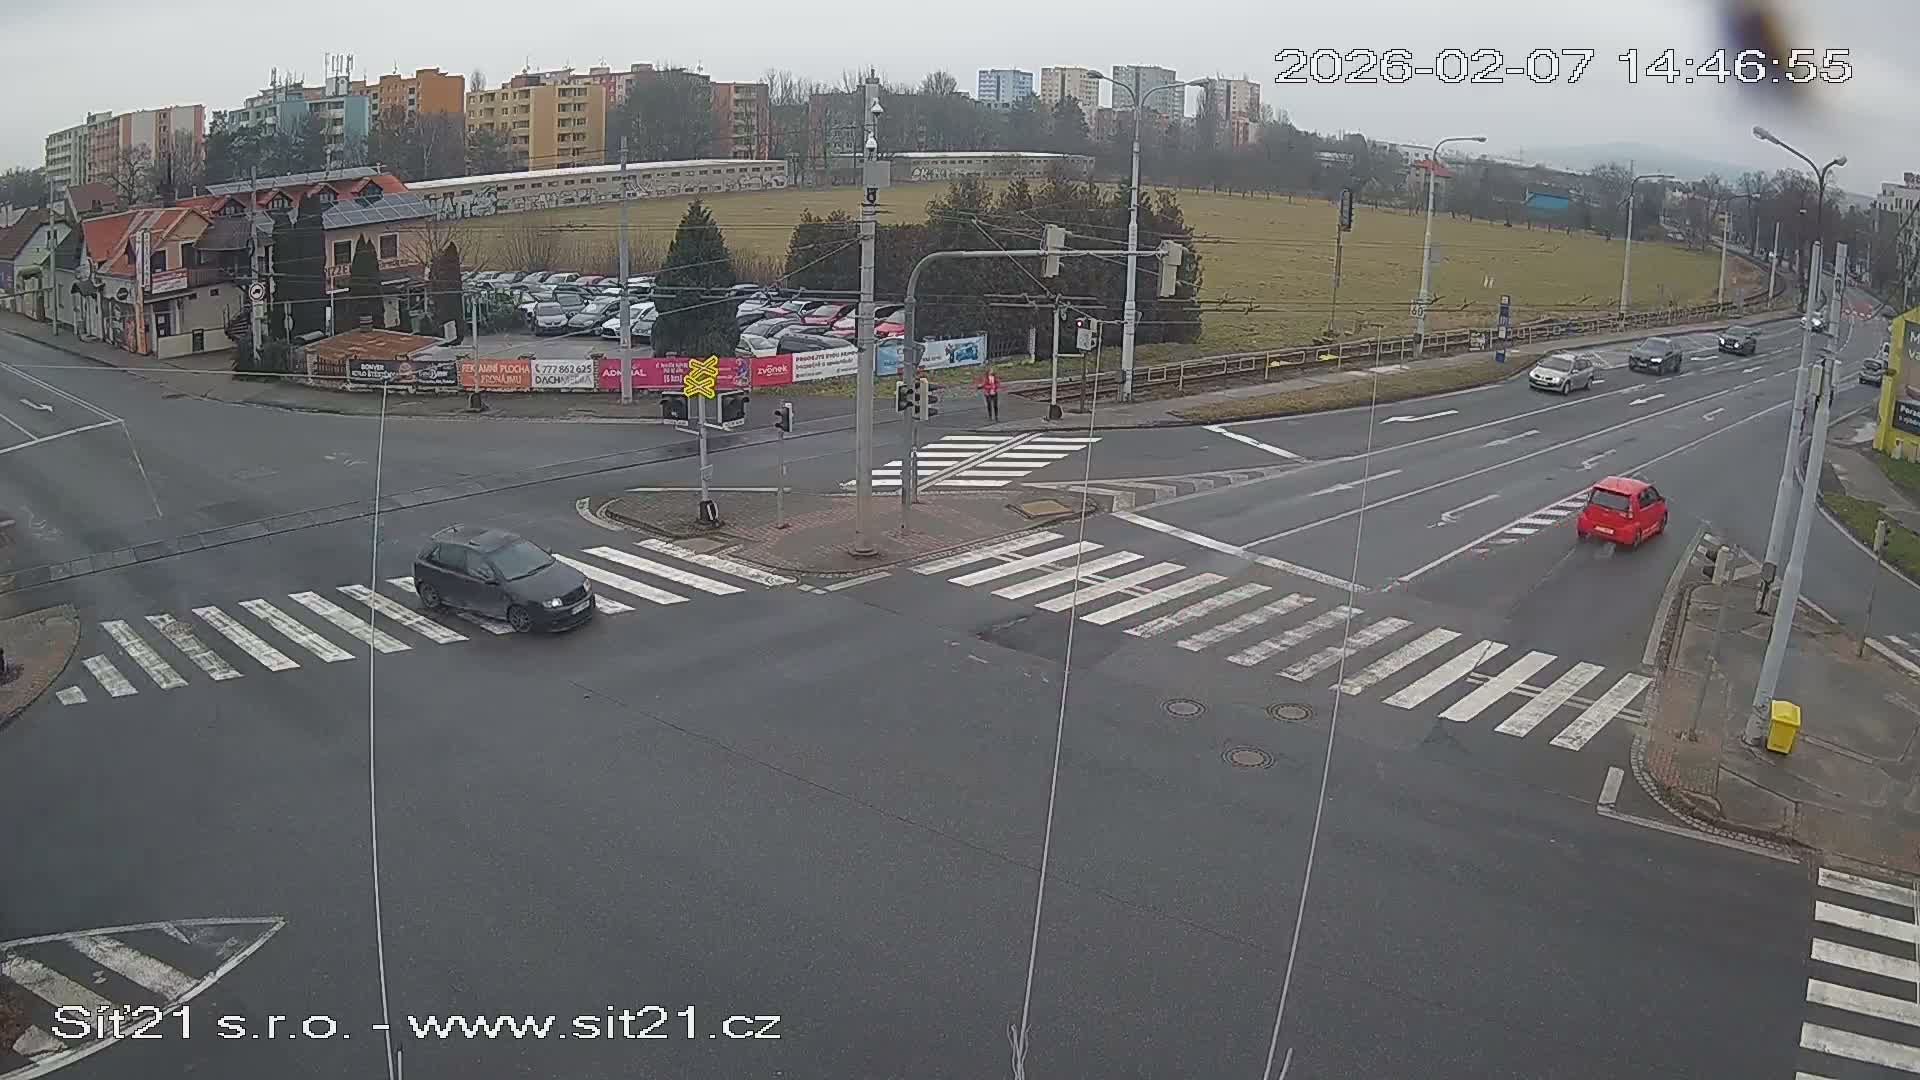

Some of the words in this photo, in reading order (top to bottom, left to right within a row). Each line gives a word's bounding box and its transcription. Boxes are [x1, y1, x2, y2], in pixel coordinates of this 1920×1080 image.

[1411, 306, 1424, 317] 60
[462, 363, 499, 373] REKAMNÍ
[500, 363, 530, 373] PLOCHA
[543, 365, 557, 373] 777
[559, 365, 574, 373] 862
[575, 365, 592, 373] 625
[602, 368, 647, 377] ADMAL
